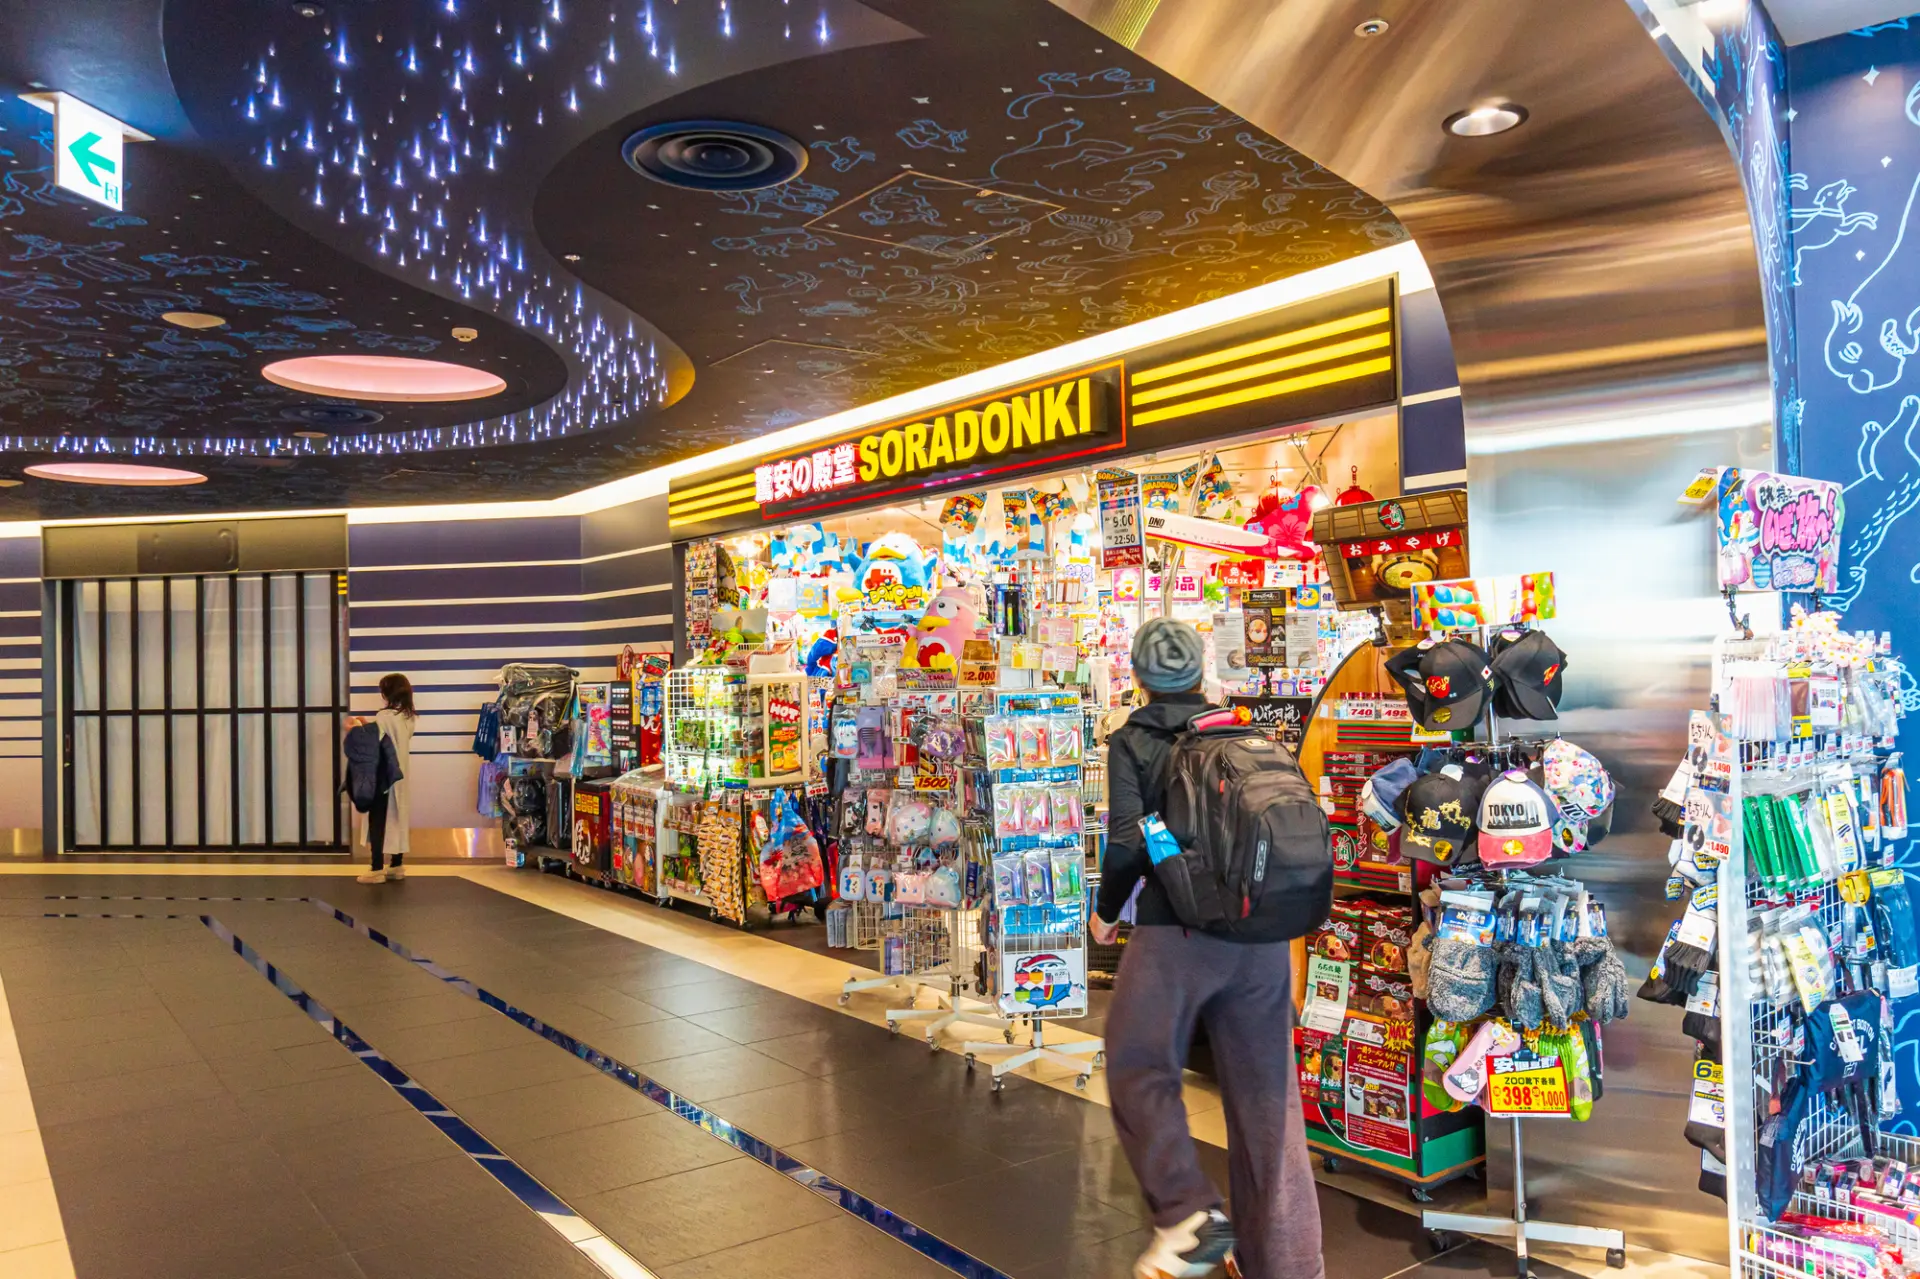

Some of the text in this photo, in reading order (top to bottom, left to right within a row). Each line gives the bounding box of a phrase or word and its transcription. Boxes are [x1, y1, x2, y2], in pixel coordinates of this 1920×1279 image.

[754, 377, 1091, 503] 驚安の殿堂 SORADONKI
[1113, 515, 1134, 527] 9:00
[1114, 534, 1136, 545] 22:50
[1350, 532, 1450, 556] おみやげ
[880, 636, 900, 645] 280
[770, 702, 799, 720] HOT
[1385, 709, 1407, 717] 498
[918, 777, 948, 788] 1500
[1488, 803, 1524, 817] TOKYO
[1503, 1086, 1532, 1106] 398
[1541, 1090, 1565, 1107] 1,000
